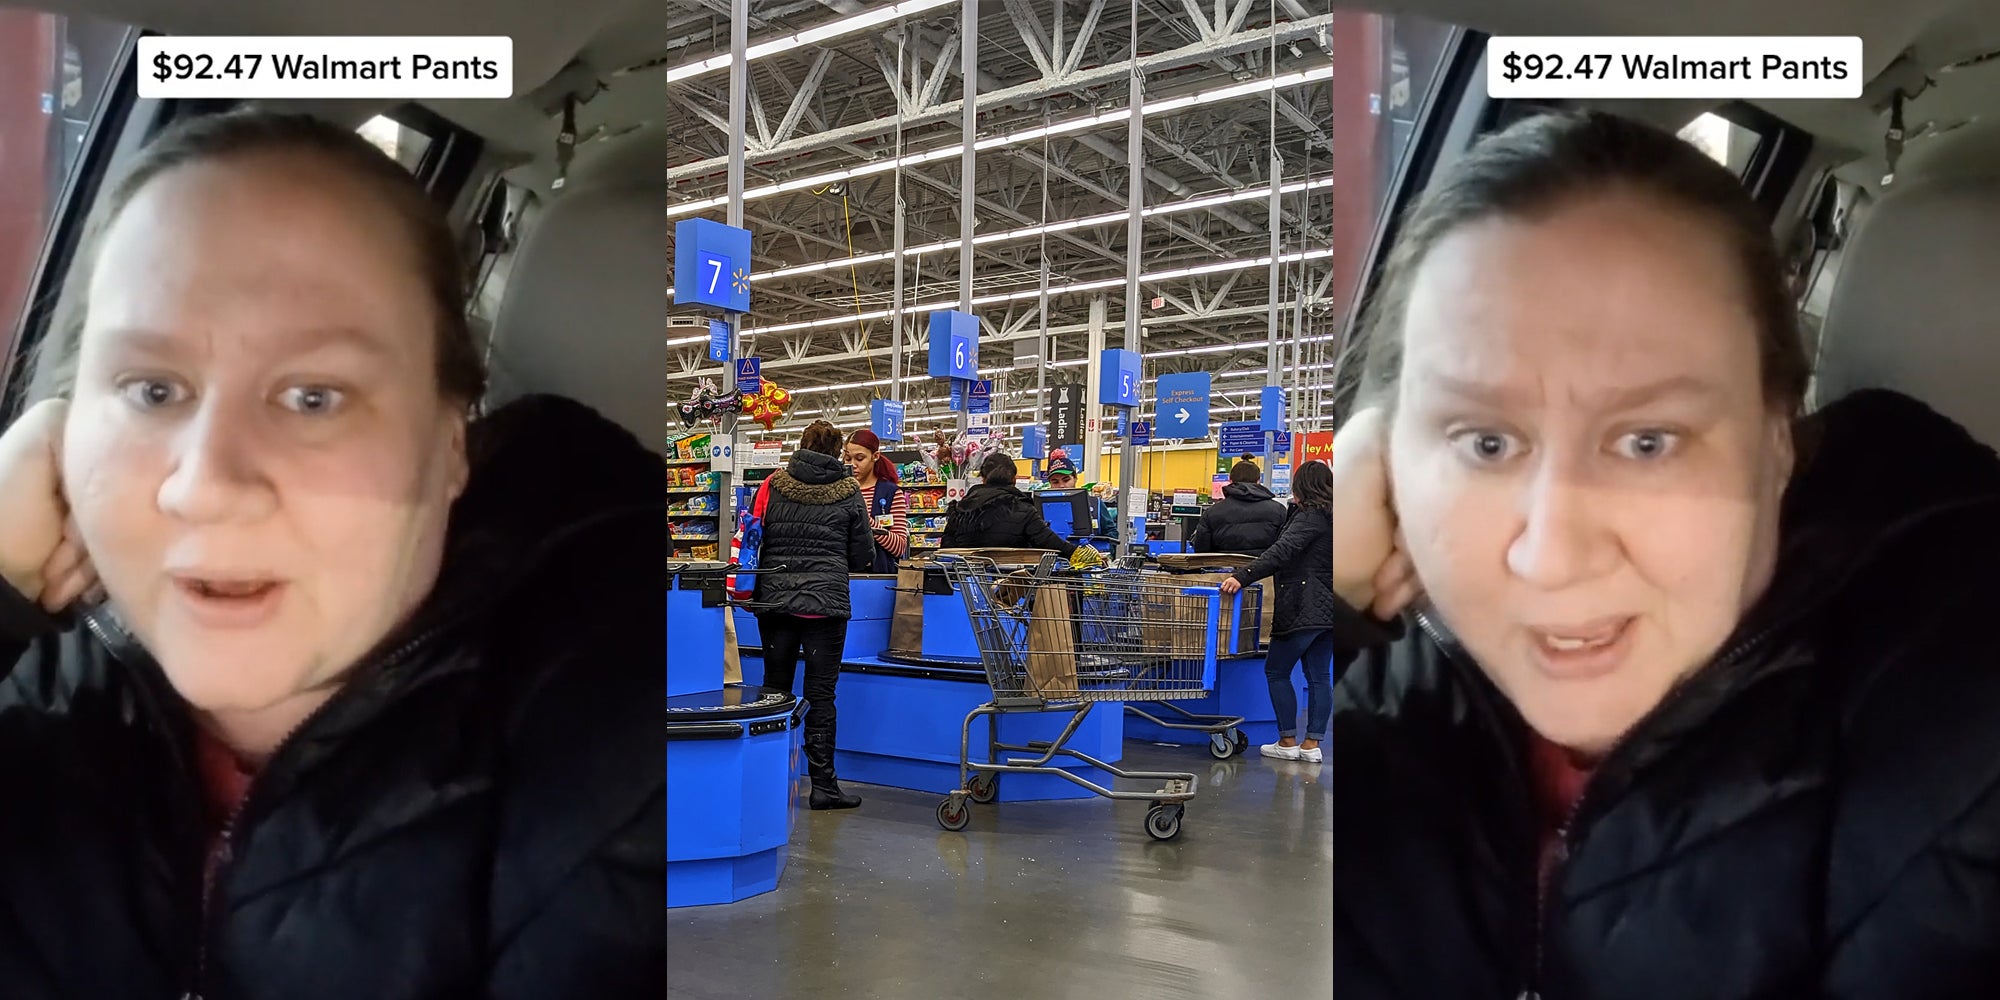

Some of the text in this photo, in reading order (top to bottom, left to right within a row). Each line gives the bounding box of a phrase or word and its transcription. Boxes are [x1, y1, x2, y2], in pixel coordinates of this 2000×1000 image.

[708, 259, 721, 294] 7
[955, 342, 964, 369] 6
[1122, 375, 1129, 398] 5
[887, 418, 893, 435] 3
[1057, 407, 1068, 439] Ladies
